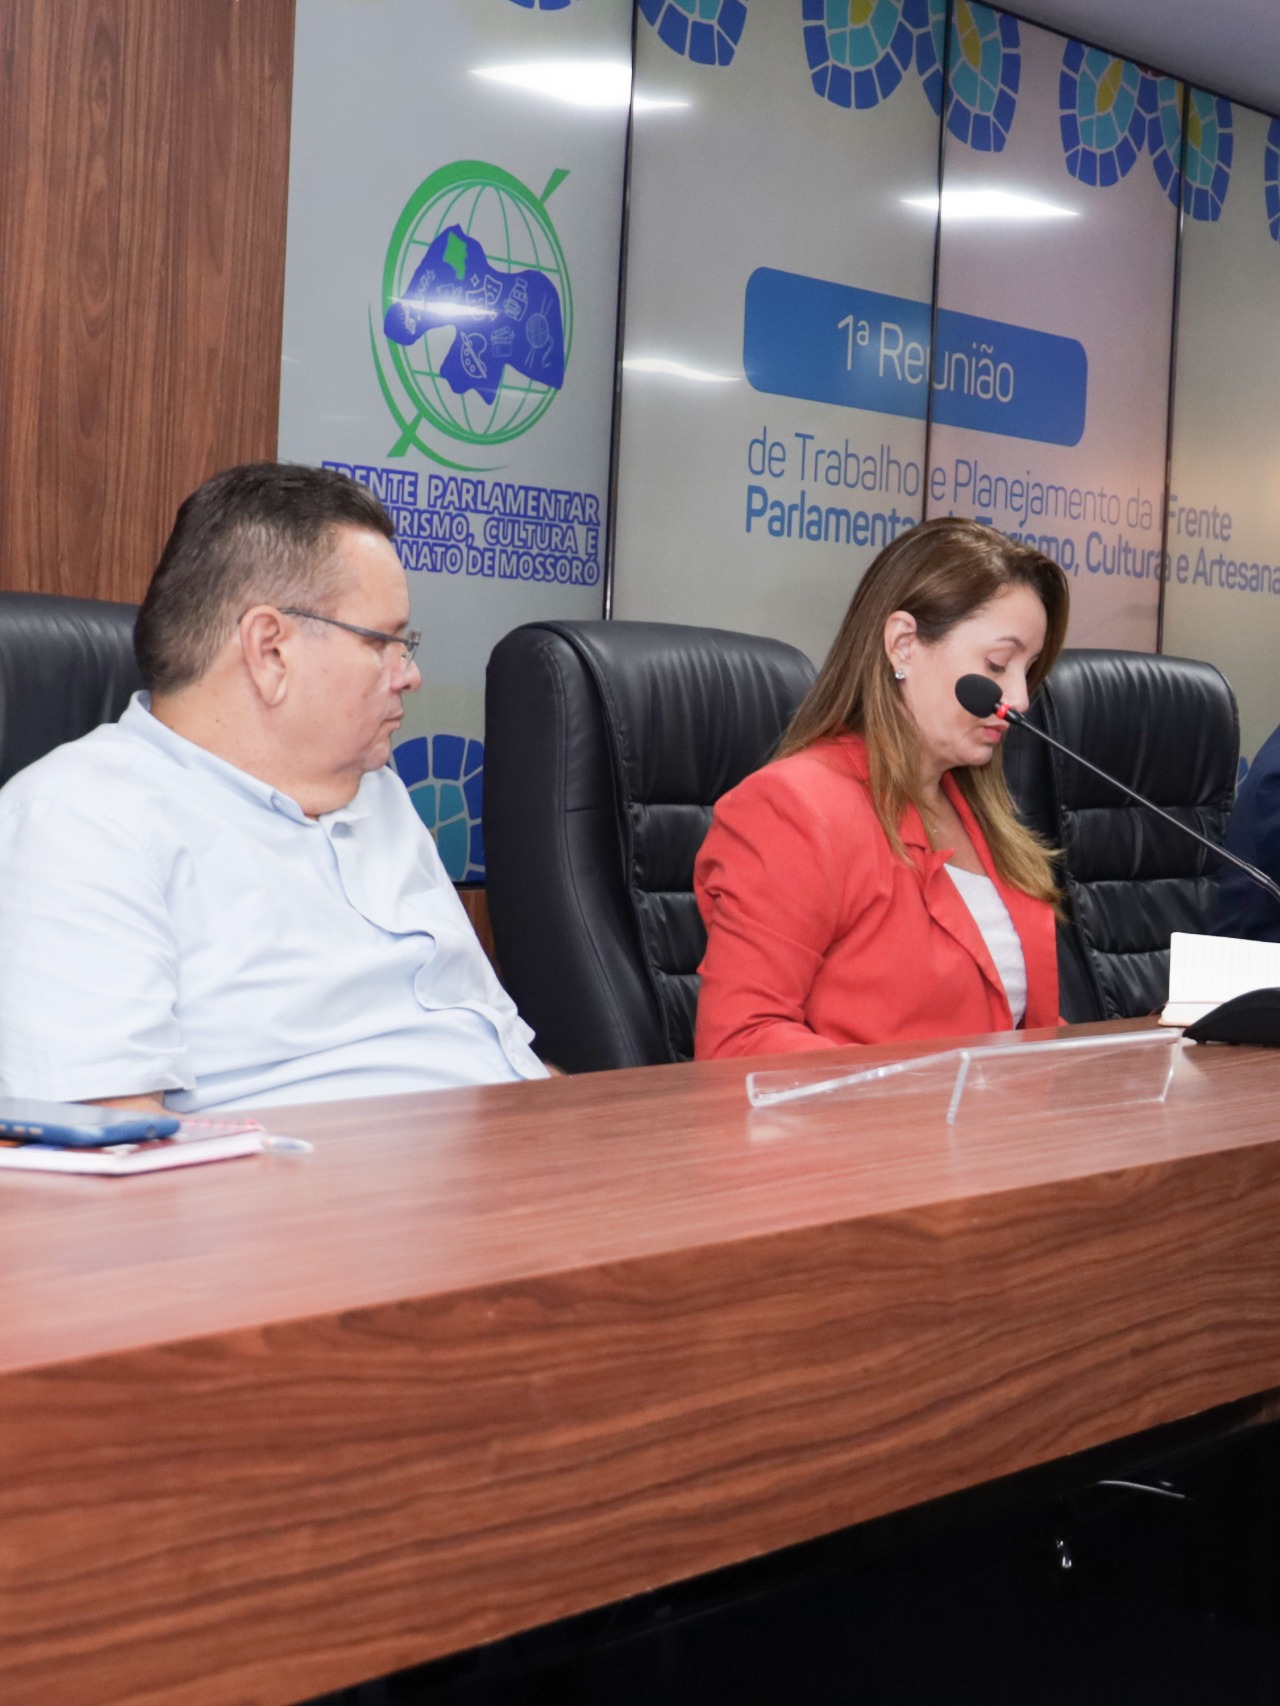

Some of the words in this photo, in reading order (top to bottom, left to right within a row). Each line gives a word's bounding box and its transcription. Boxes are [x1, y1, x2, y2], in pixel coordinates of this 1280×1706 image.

[878, 320, 1015, 404] Reunião
[428, 474, 600, 526] PARLAMENTAR
[748, 425, 786, 478] de
[794, 432, 921, 497] Trabalho
[930, 466, 948, 501] e
[953, 459, 1121, 528] Planejamento
[1126, 486, 1153, 531] da
[1160, 491, 1232, 542] Frente
[484, 517, 579, 555] CULTURA
[585, 527, 600, 556] E
[1086, 530, 1172, 583] Cultura
[1176, 553, 1189, 584] e
[466, 548, 496, 577] DE
[498, 549, 600, 586] MOSSORÓ
